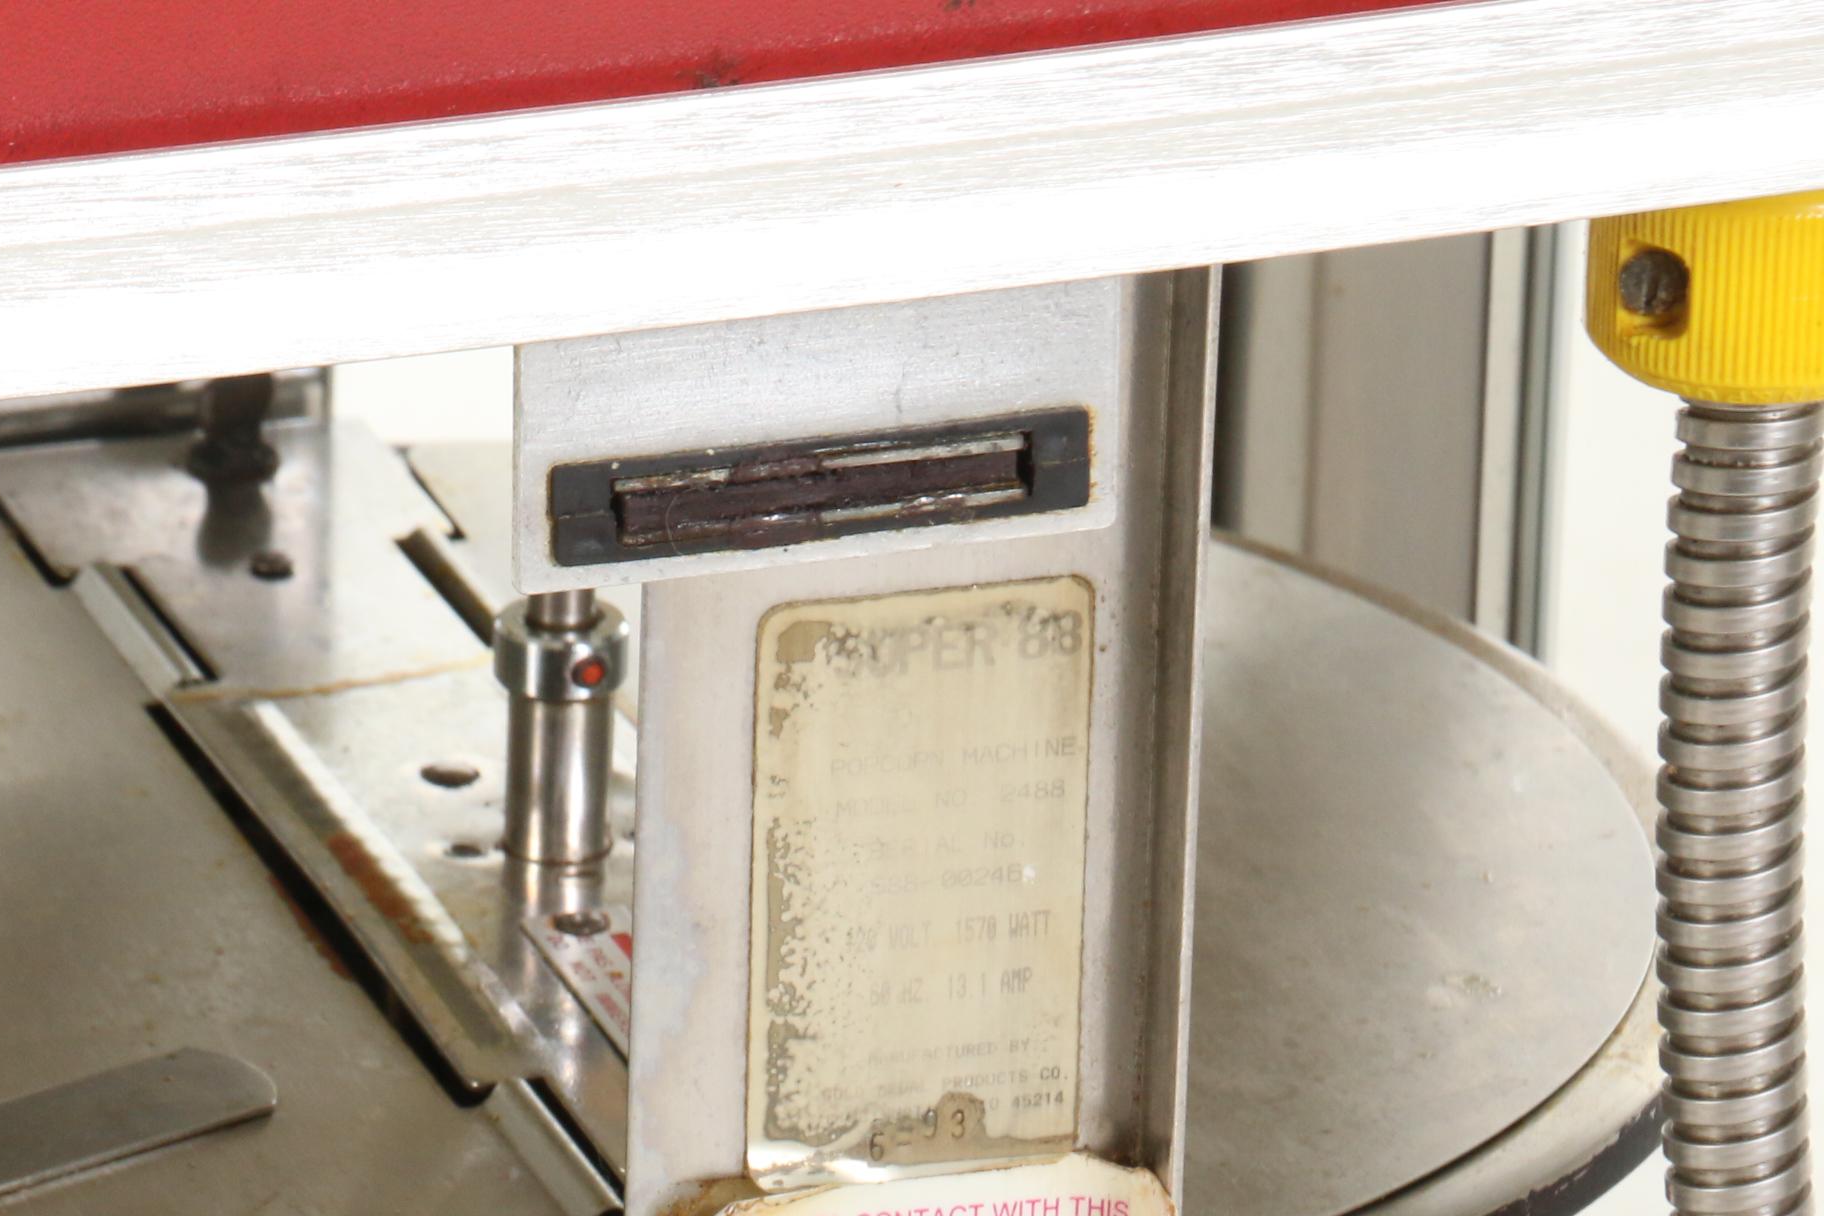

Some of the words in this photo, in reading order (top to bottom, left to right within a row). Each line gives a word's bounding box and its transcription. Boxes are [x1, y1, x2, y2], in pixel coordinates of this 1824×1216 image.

[1000, 778, 1066, 804] 2488
[1008, 909, 1052, 939] WATT
[1000, 966, 1033, 995] AMP
[942, 1069, 1029, 1091] PRODUCTS
[1040, 1065, 1069, 1082] CO.
